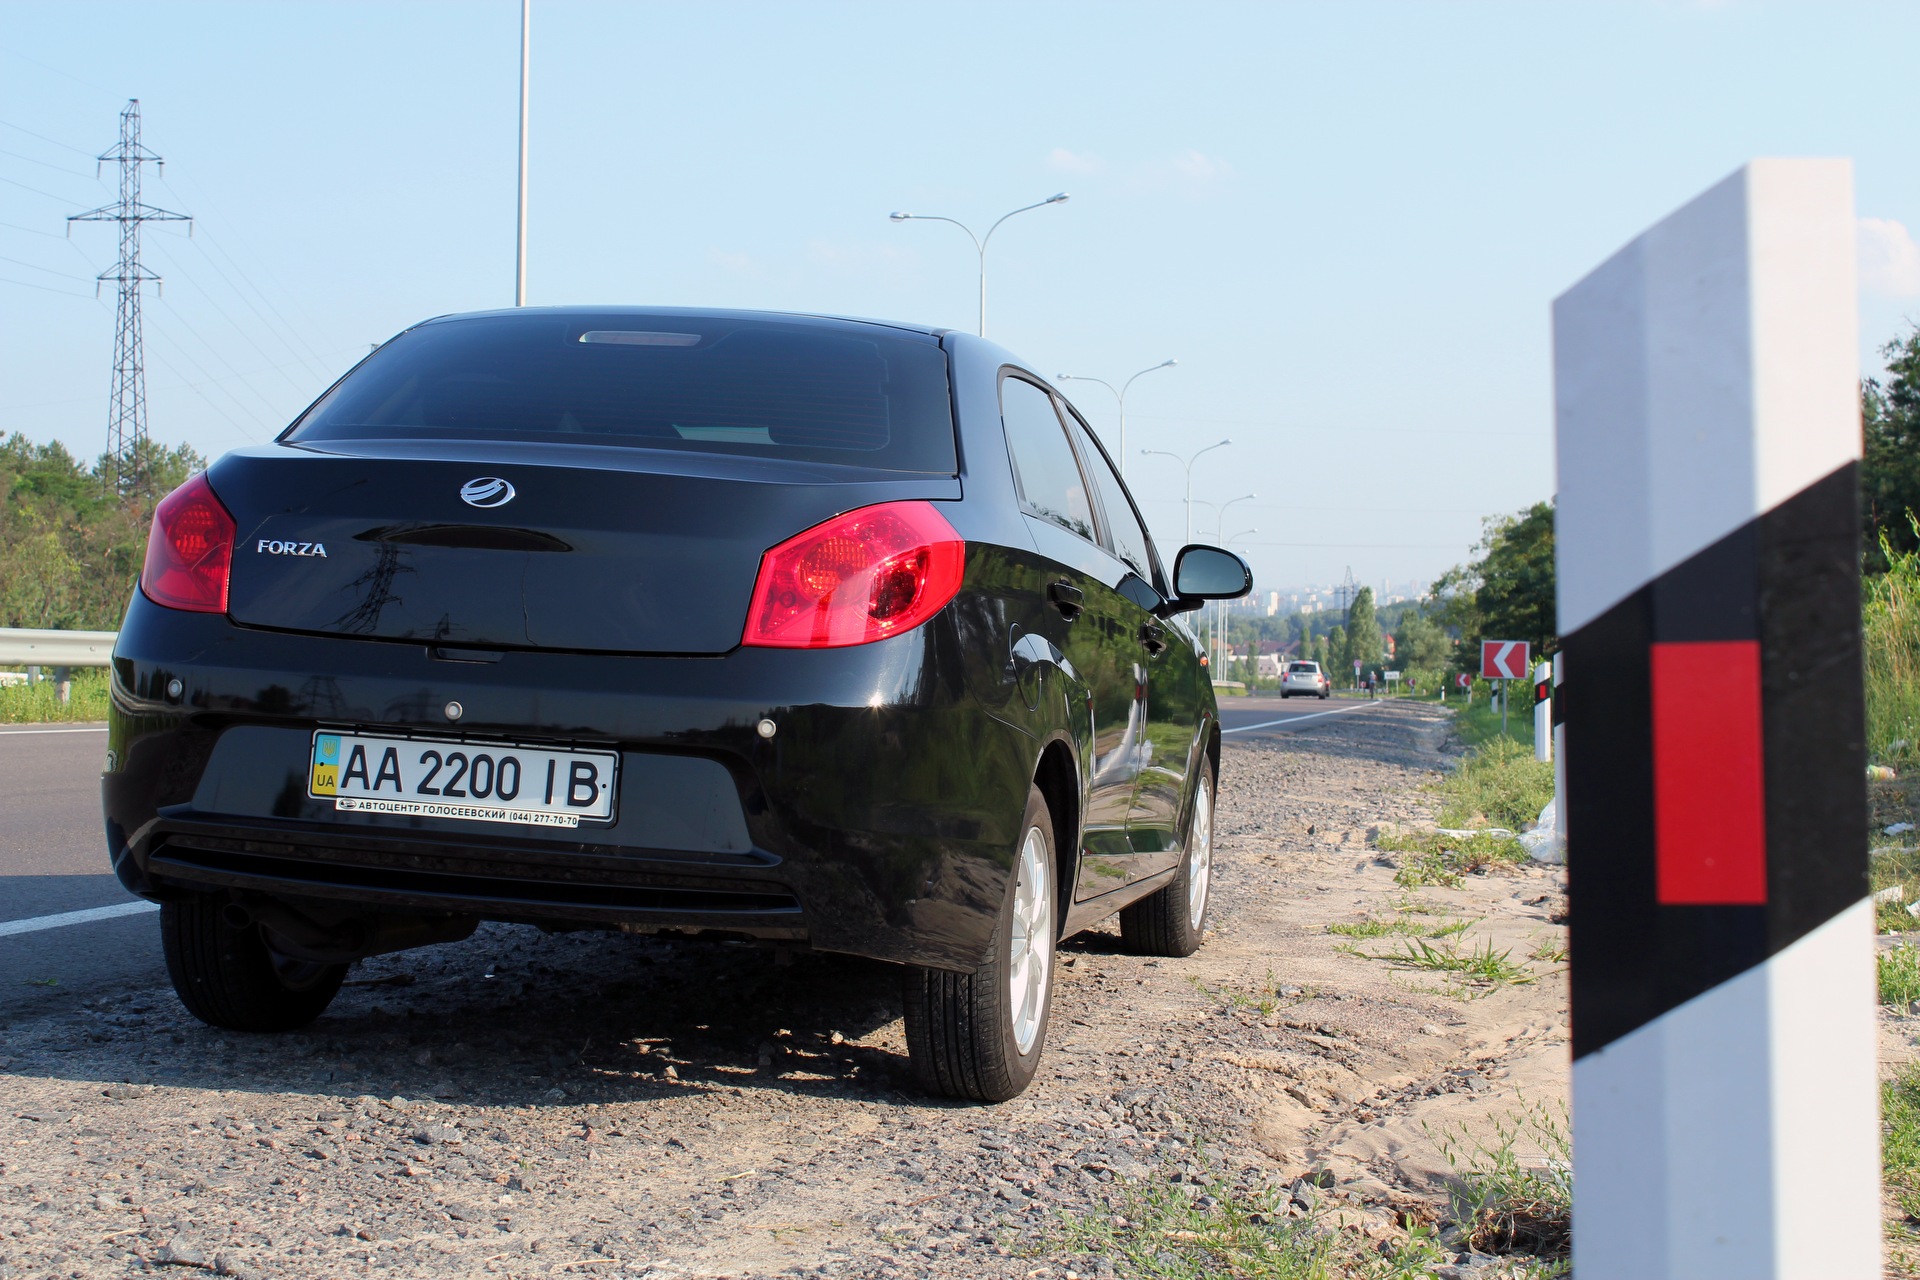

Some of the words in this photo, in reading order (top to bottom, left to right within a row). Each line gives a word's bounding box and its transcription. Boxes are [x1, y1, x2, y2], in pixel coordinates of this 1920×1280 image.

[257, 539, 328, 558] FORZA
[317, 774, 335, 787] UA
[341, 744, 403, 793] AA
[417, 750, 521, 801] 2200
[545, 758, 599, 807] IB
[358, 801, 420, 813] АВТОЦЕНТР
[423, 805, 506, 819] ГОЛОСЕЕВСКИЙ
[509, 812, 532, 823] (044)
[534, 814, 578, 825] 277-70-70
